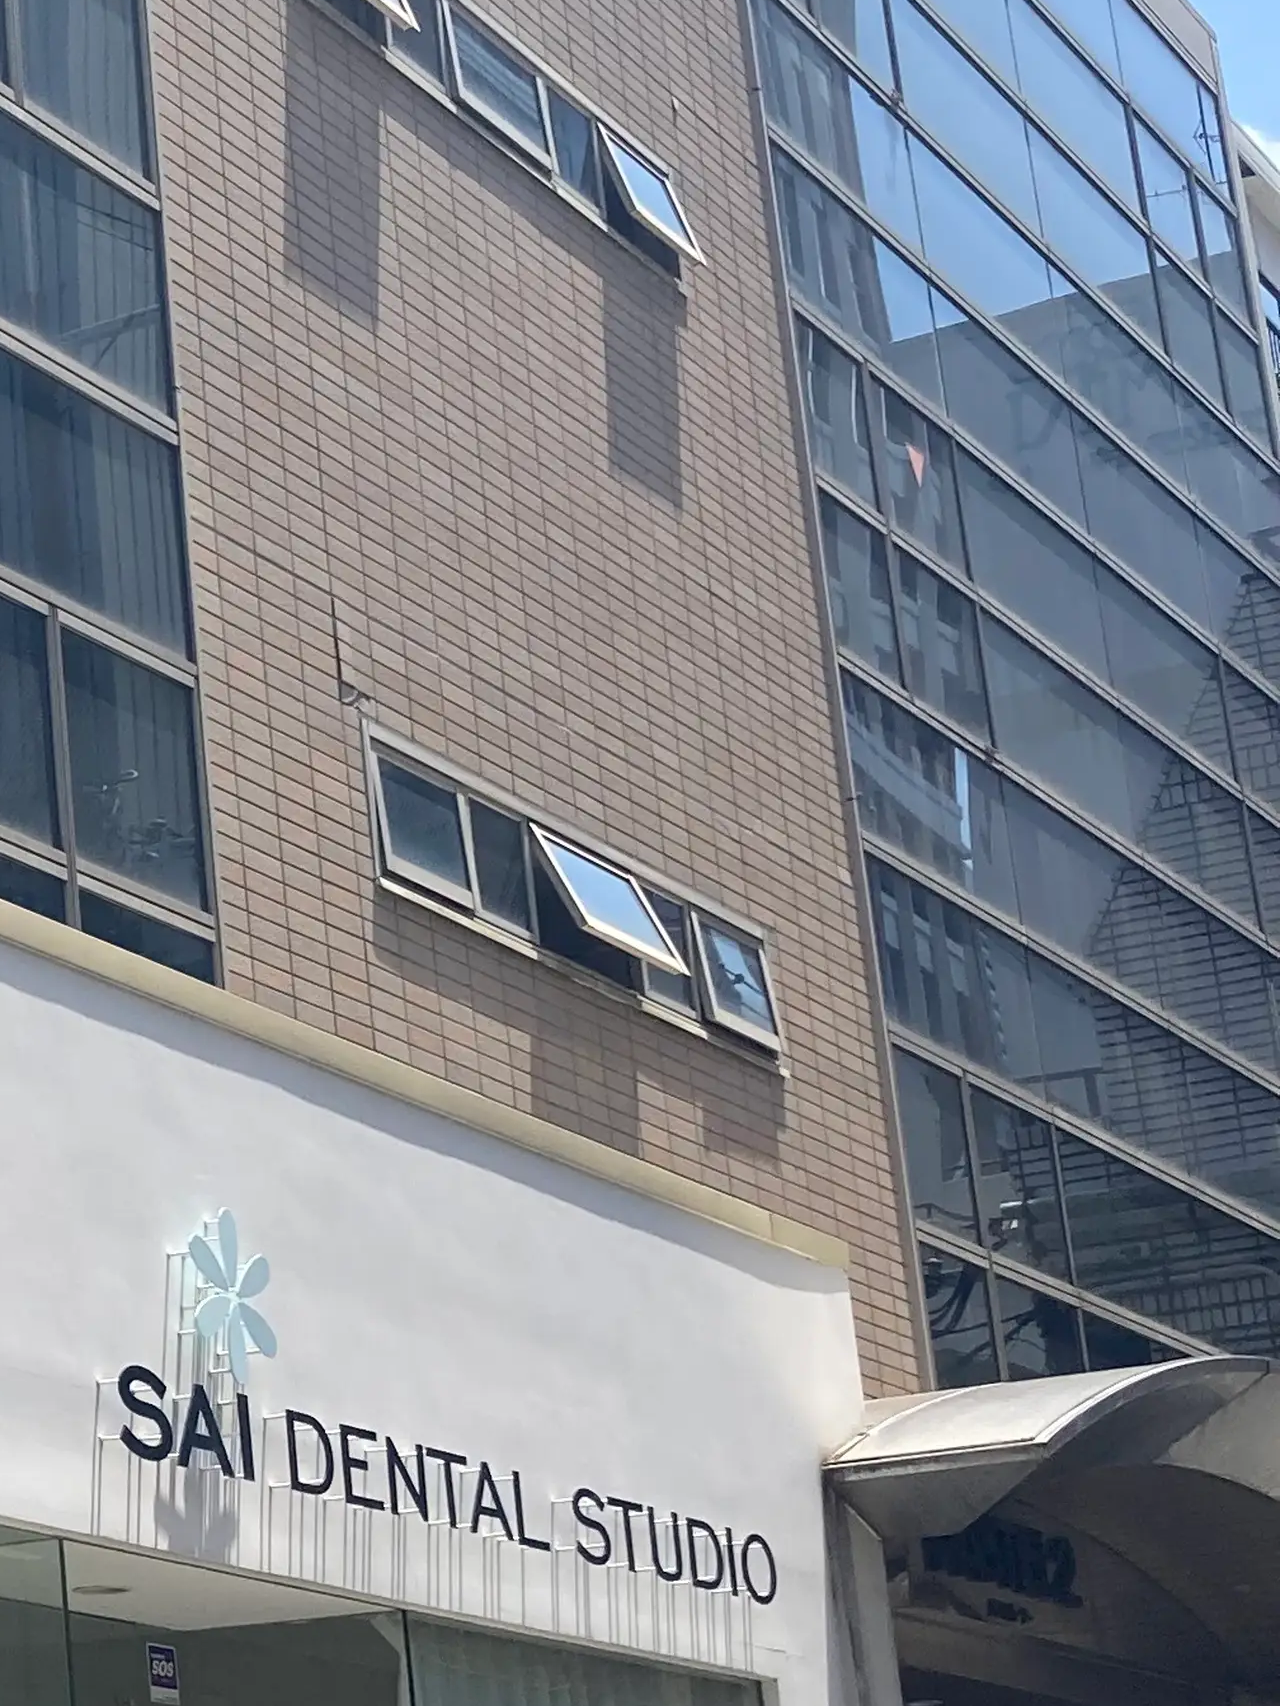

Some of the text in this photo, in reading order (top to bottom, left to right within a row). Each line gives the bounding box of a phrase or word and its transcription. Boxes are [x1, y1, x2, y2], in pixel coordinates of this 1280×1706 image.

[118, 1364, 257, 1482] SAI
[285, 1408, 551, 1552] DENTAL
[572, 1487, 779, 1606] STUDIO
[151, 1660, 174, 1678] SOS
